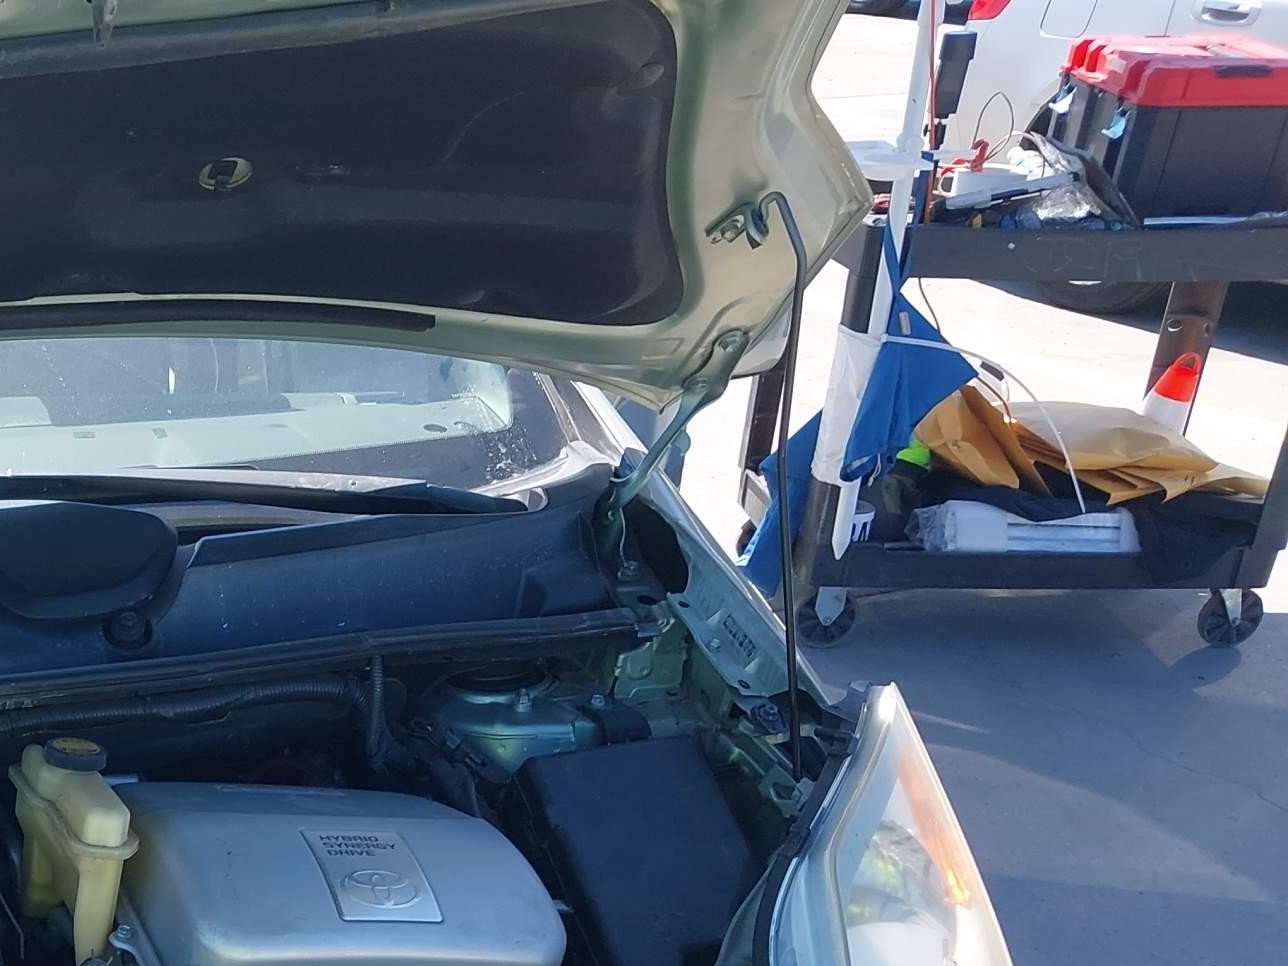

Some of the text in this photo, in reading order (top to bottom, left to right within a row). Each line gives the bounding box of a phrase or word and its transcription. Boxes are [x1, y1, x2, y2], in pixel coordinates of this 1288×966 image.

[319, 835, 379, 843] HYBRID
[323, 842, 397, 850] SYNERGY
[327, 849, 377, 857] DRIVE
